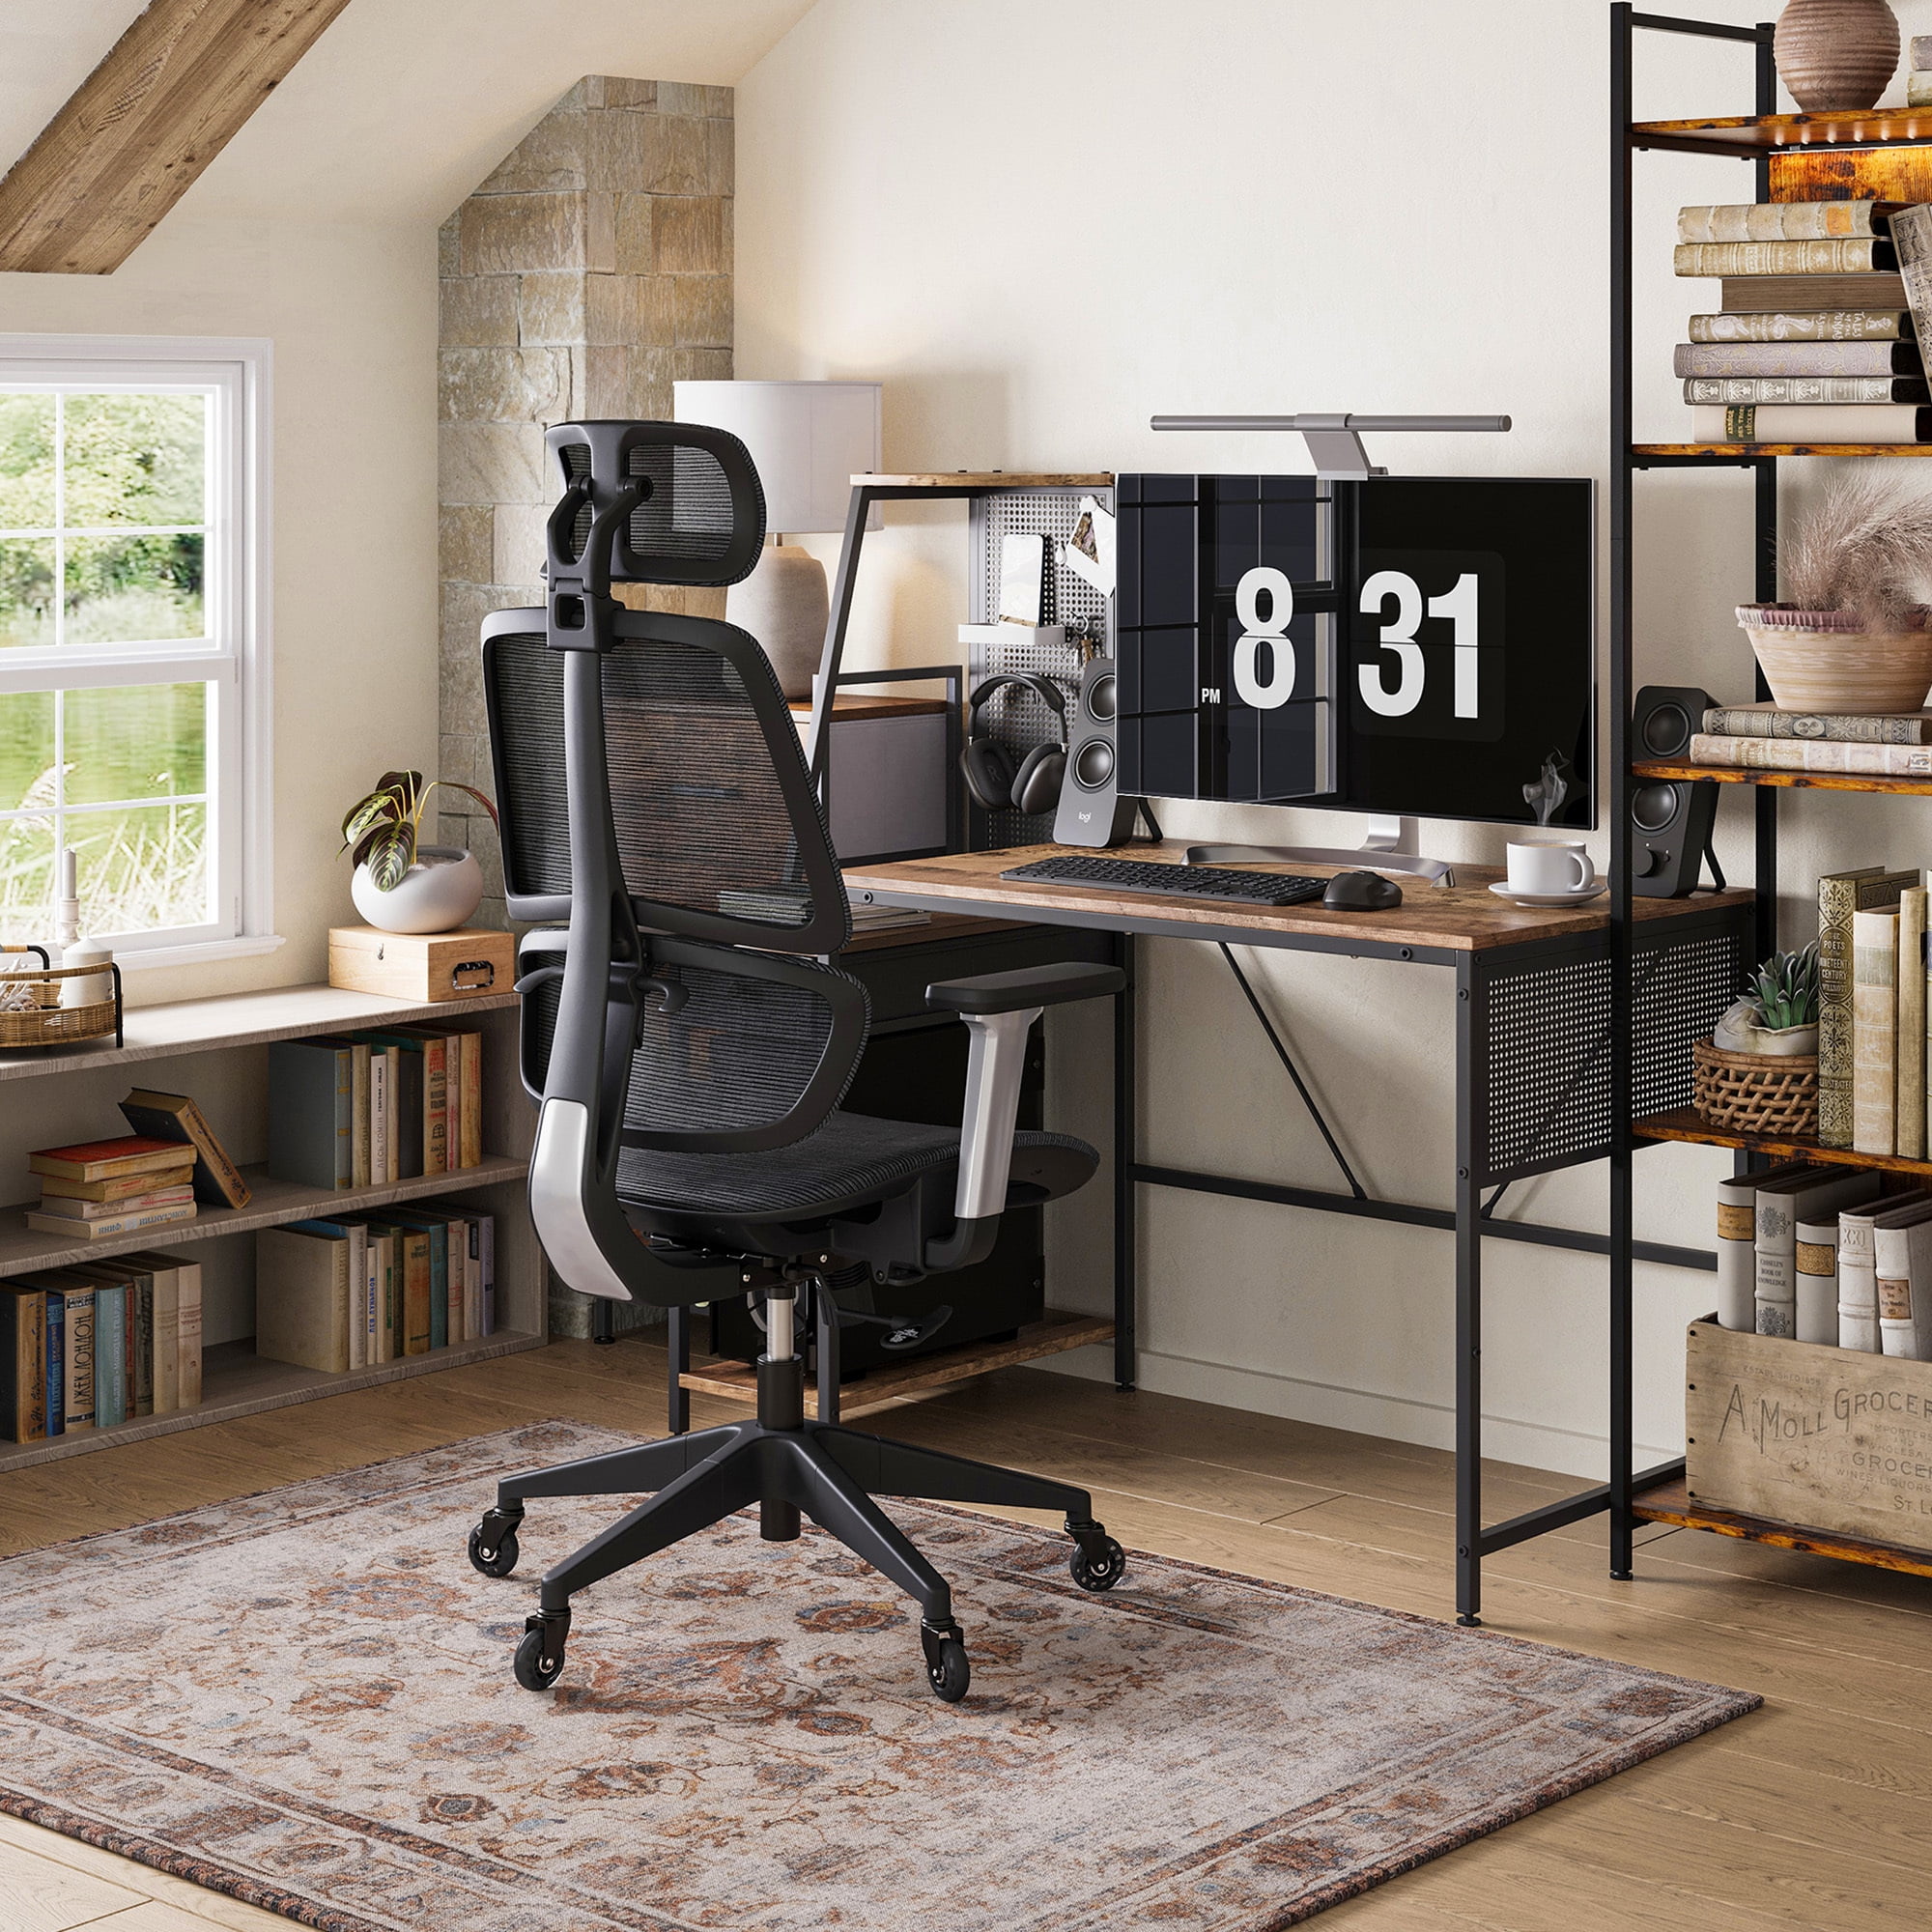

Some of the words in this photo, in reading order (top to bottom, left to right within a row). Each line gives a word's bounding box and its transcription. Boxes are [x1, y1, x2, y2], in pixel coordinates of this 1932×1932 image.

[1234, 566, 1295, 710] 8
[1358, 570, 1479, 719] 31
[1201, 688, 1221, 704] PM
[1078, 811, 1093, 824] logi
[1823, 939, 1847, 951] POETS
[1822, 968, 1849, 981] CENTURY
[72, 1314, 92, 1370] ЛОНДОН
[72, 1371, 93, 1406] ДЖЕК
[1760, 1399, 1828, 1454] MOLL
[1852, 1451, 1932, 1480] GROCE
